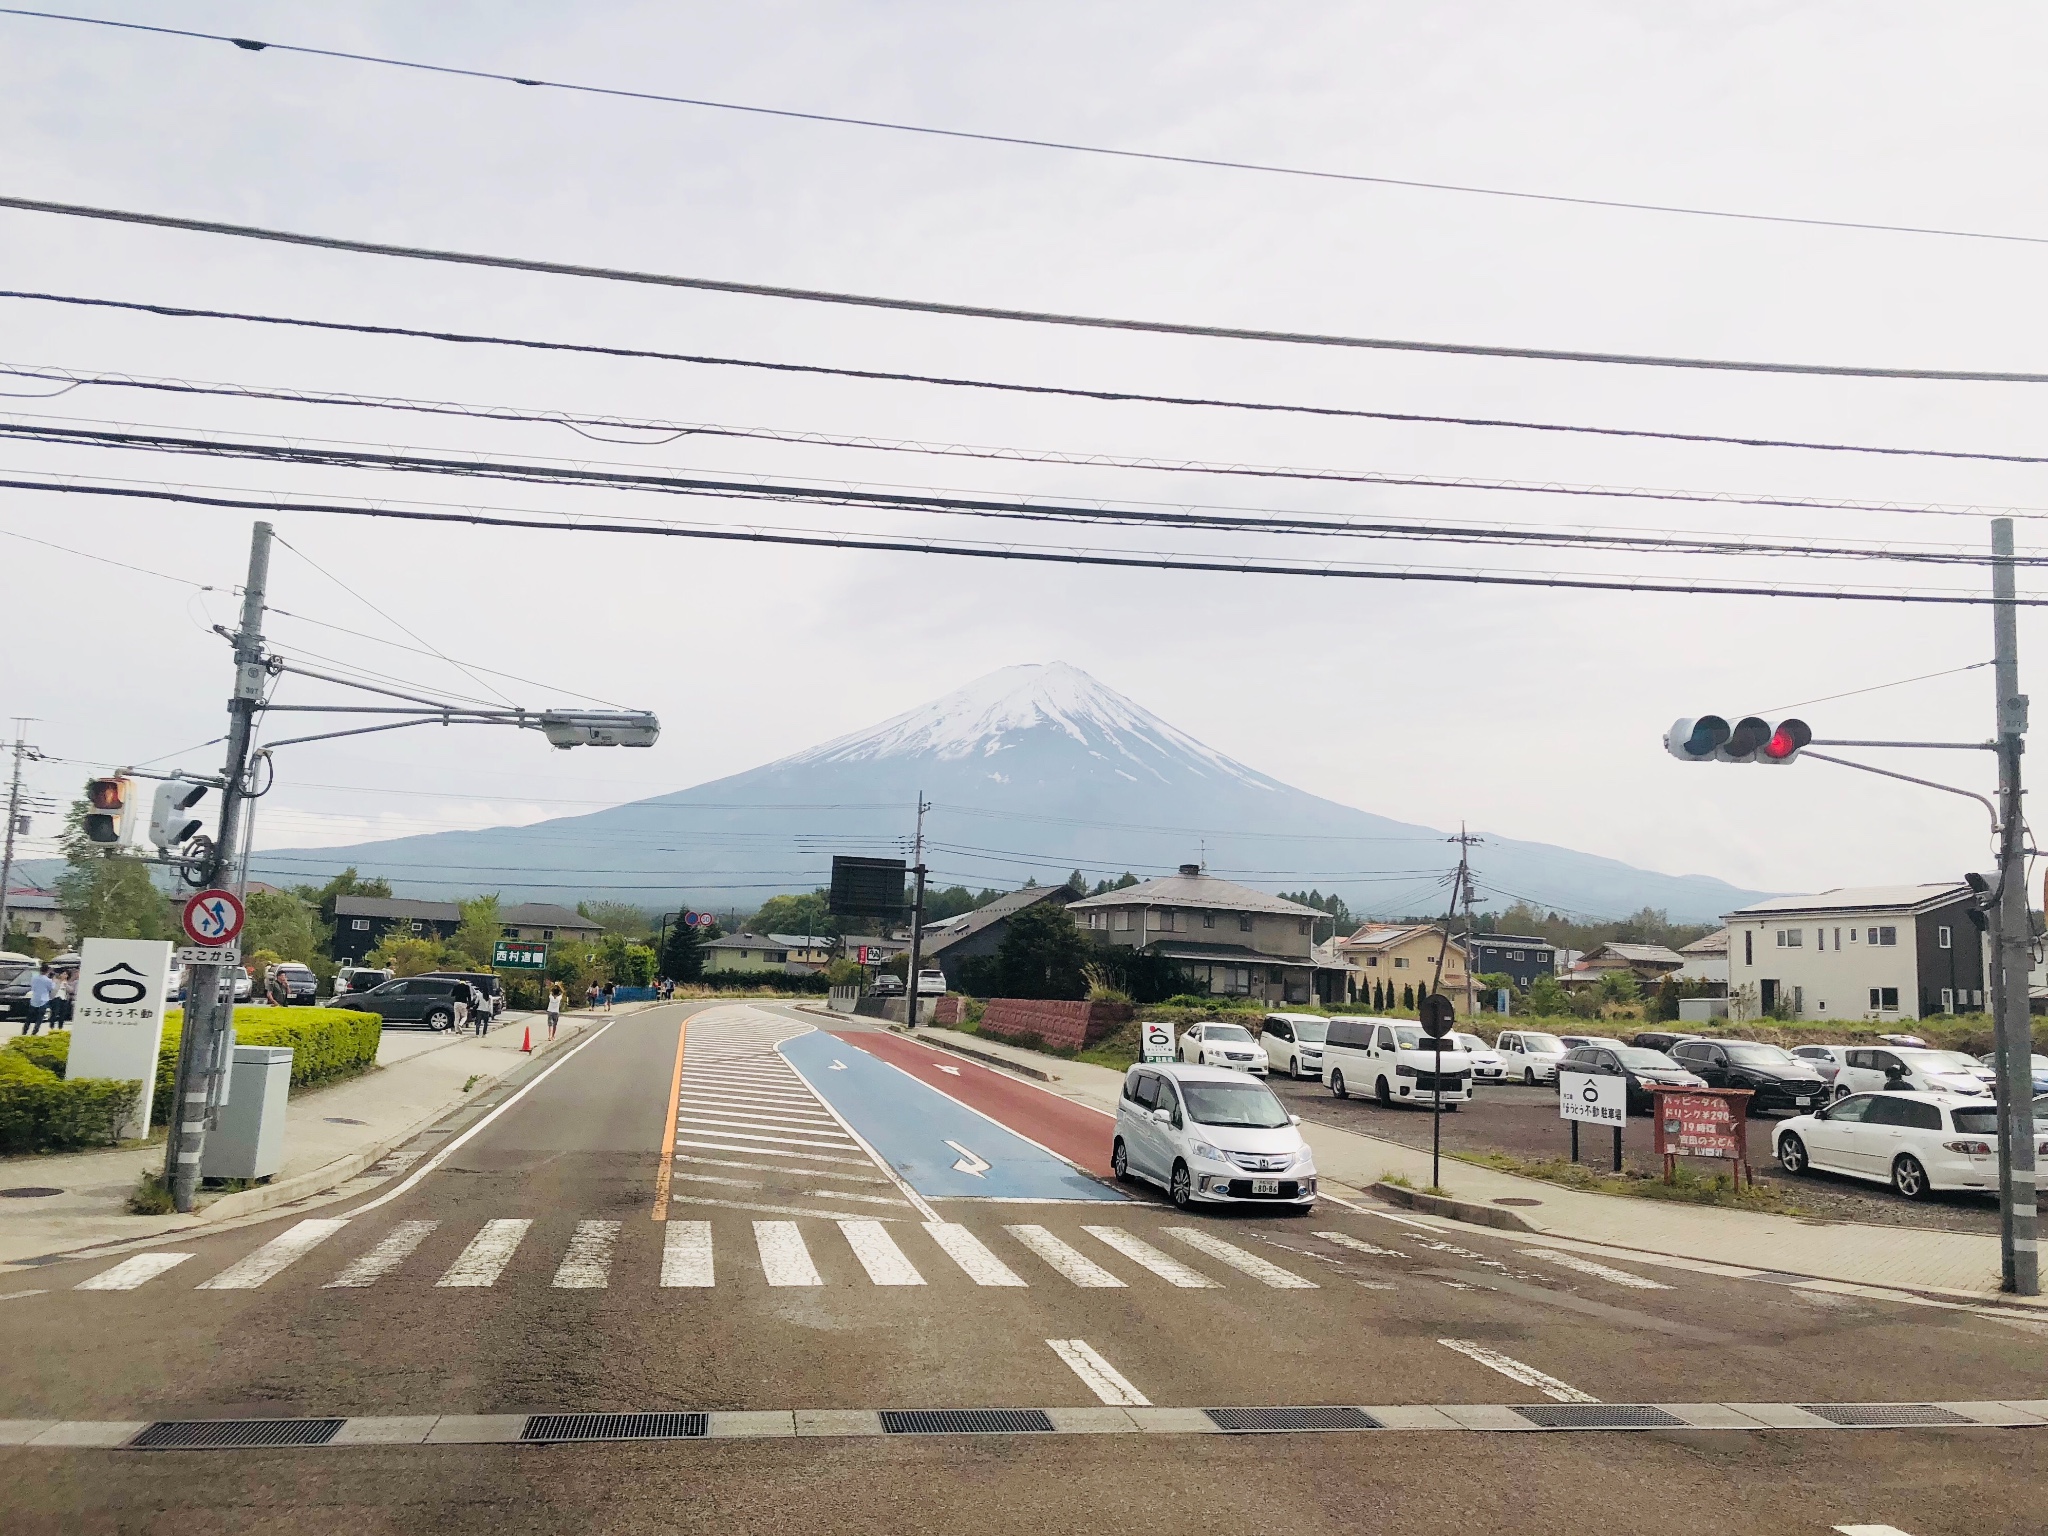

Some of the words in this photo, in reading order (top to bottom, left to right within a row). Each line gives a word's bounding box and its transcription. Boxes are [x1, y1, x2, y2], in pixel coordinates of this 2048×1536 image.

[182, 950, 235, 961] ここから
[80, 1007, 153, 1018] ほうとう不動
